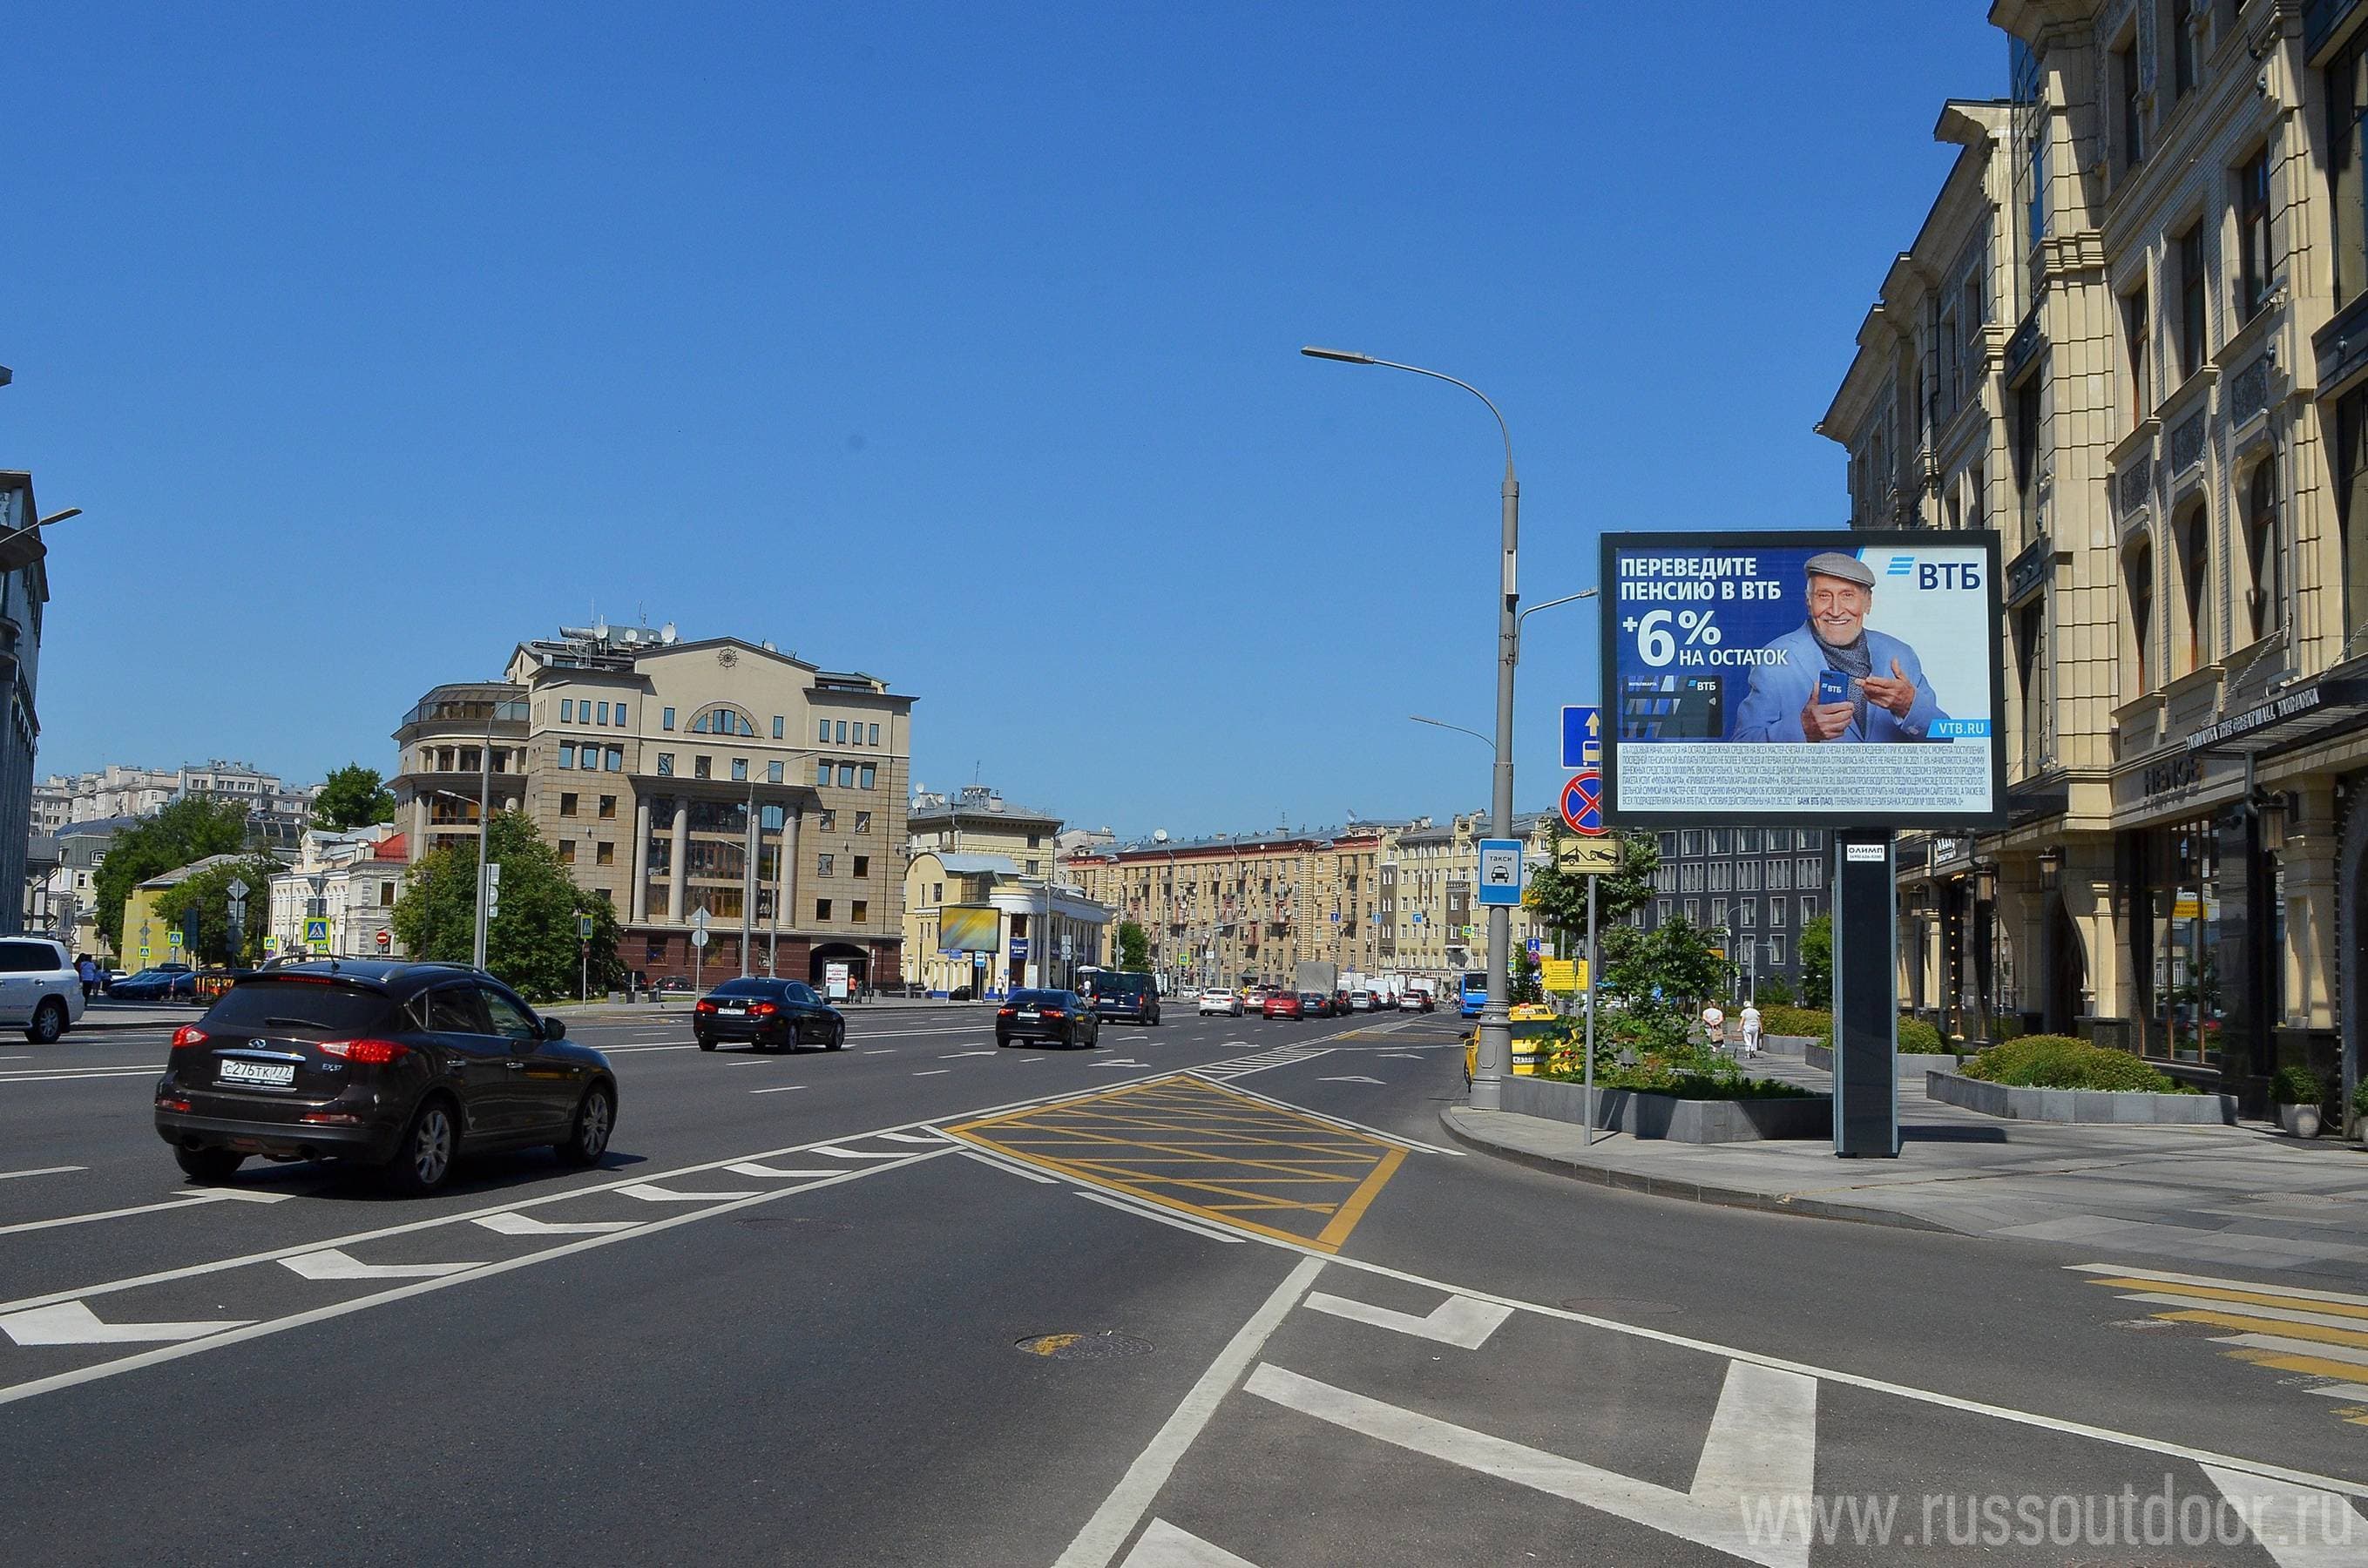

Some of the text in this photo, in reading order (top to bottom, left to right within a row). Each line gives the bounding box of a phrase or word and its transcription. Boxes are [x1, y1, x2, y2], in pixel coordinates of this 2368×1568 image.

[1621, 558, 1756, 580] ПЕРЕВЕДИТЕ
[1919, 564, 1980, 590] ВТБ
[1621, 581, 1782, 600] ПЕНСИЮ В ВТБ
[1680, 649, 1789, 666] НА ОСТАТОК
[1697, 681, 1716, 691] ВТБ
[1828, 685, 1842, 693] ВТБ
[1938, 723, 1985, 734] VTB.RU
